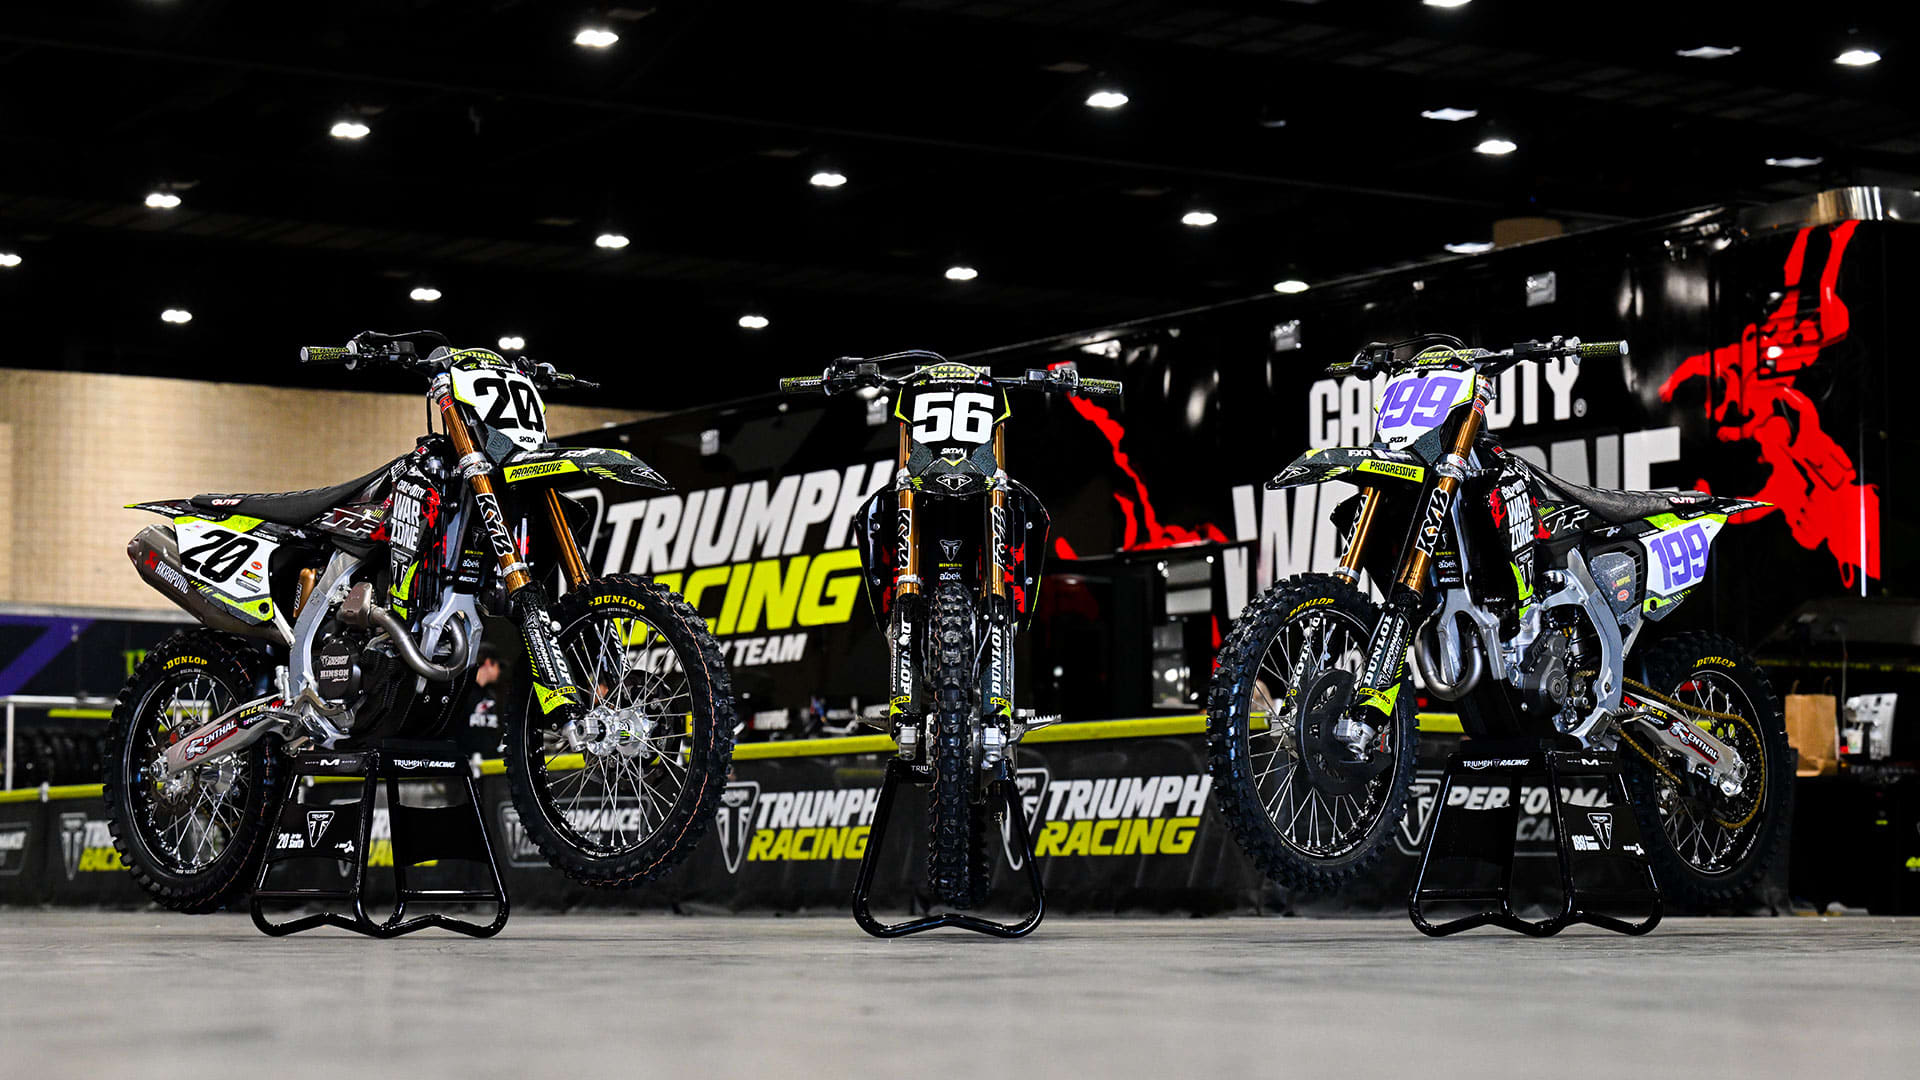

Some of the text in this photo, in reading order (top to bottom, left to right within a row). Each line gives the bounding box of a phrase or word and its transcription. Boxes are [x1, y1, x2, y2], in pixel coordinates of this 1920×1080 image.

[473, 377, 545, 434] 20
[912, 391, 995, 444] 56
[1376, 376, 1463, 432] 199
[509, 462, 562, 479] PROGRESSIVE
[1370, 460, 1418, 478] PROGRESSIVE
[210, 498, 243, 506] GUTS
[394, 492, 420, 527] WAR
[601, 459, 895, 578] TRIUMPH
[1505, 492, 1531, 527] WAR
[391, 518, 419, 551] ZONE
[1414, 487, 1448, 557] KYB
[1508, 517, 1534, 552] ZONE
[179, 530, 259, 583] 20
[1650, 523, 1710, 590] 199
[593, 595, 645, 611] DUNLOP
[165, 656, 208, 670] DUNLOP
[732, 633, 808, 667] TEAM
[1694, 656, 1737, 669] DUNLOP
[320, 669, 350, 679] HINSON
[393, 759, 457, 769] TRIUMPH RACING
[1463, 759, 1530, 770] TRIUMPH RACING
[1045, 774, 1212, 821] TRIUMPH
[276, 833, 291, 849] 20
[747, 825, 871, 861] RACING
[1034, 816, 1200, 857] RACING
